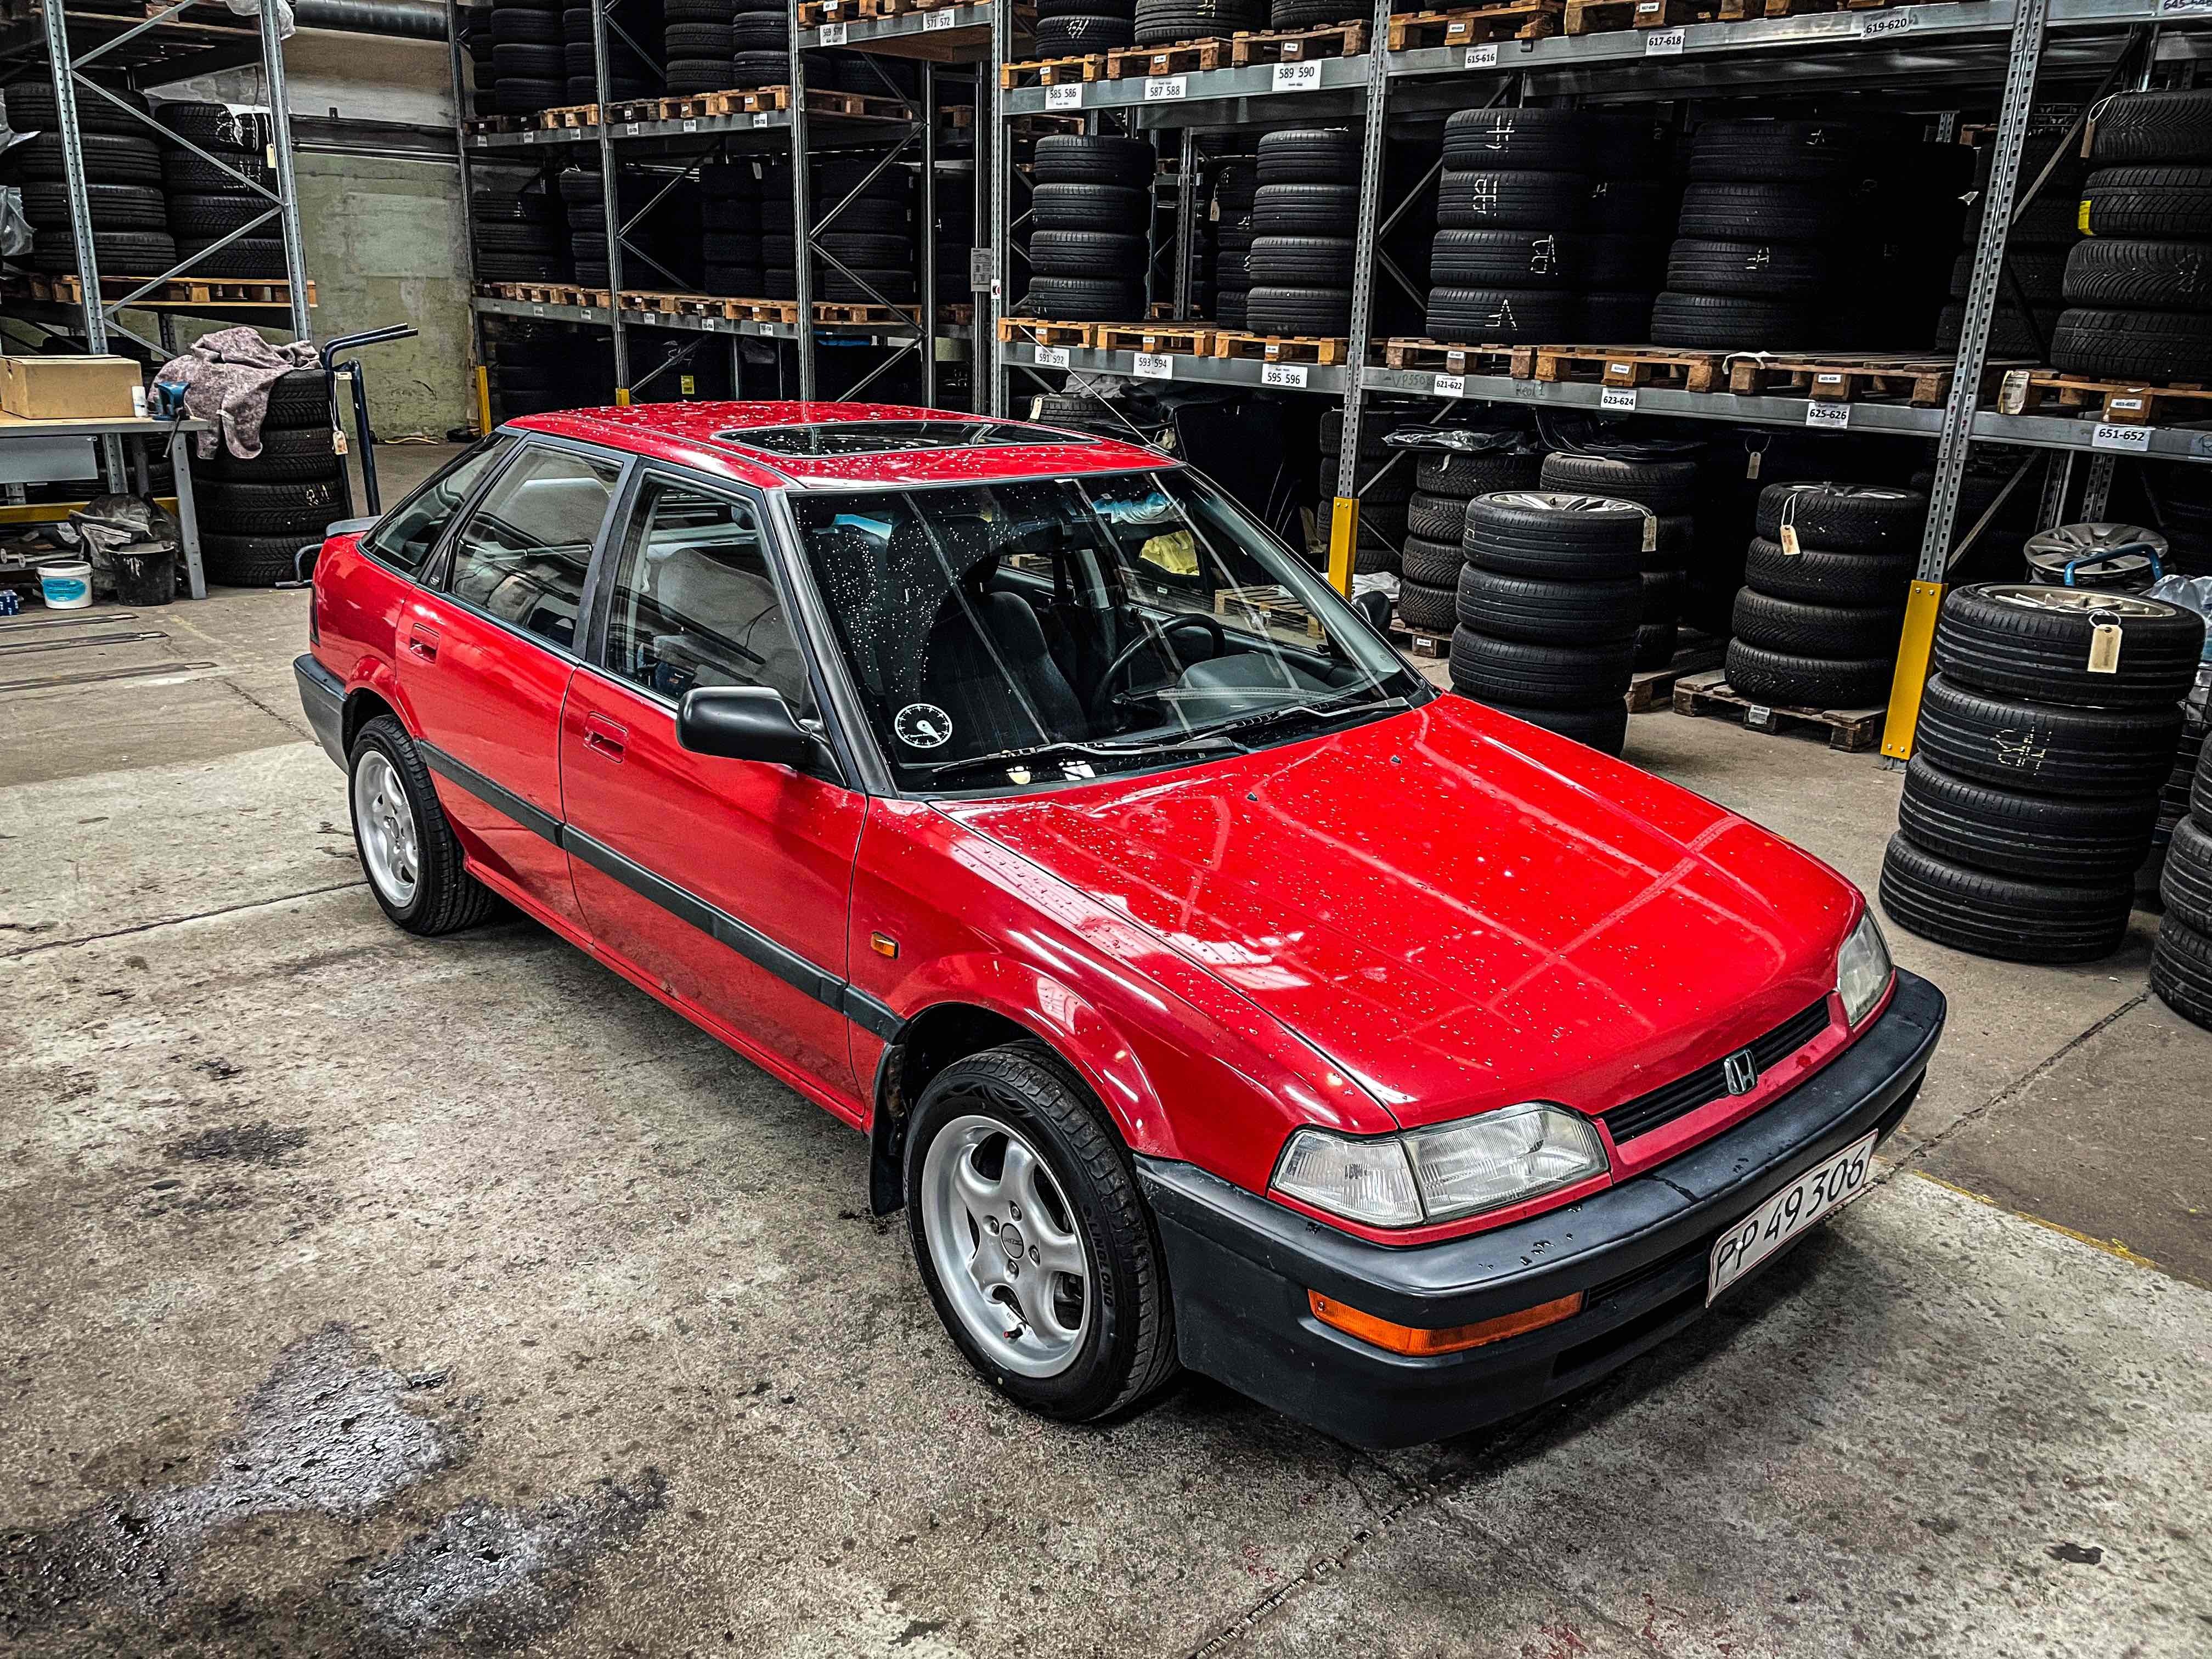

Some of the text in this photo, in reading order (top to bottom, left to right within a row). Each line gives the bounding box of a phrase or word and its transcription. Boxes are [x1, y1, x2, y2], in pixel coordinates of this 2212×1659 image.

[927, 16, 950, 29] 571 572
[1866, 18, 1907, 33] 619-620
[1649, 36, 1681, 46] 617-618
[1467, 53, 1495, 64] 615-616
[1279, 66, 1315, 79] 589 590
[1049, 88, 1077, 99] 585 586
[1150, 85, 1181, 97] 587 588
[1039, 353, 1050, 363] 591
[1138, 357, 1167, 368] 593 594
[1267, 372, 1300, 385] 595 596
[1436, 380, 1463, 390] 621-622
[1603, 396, 1634, 406] 623-624
[1809, 408, 1847, 420] 625-626
[2098, 428, 2145, 442] 651-652
[1714, 1145, 1866, 1289] PP 49 306
